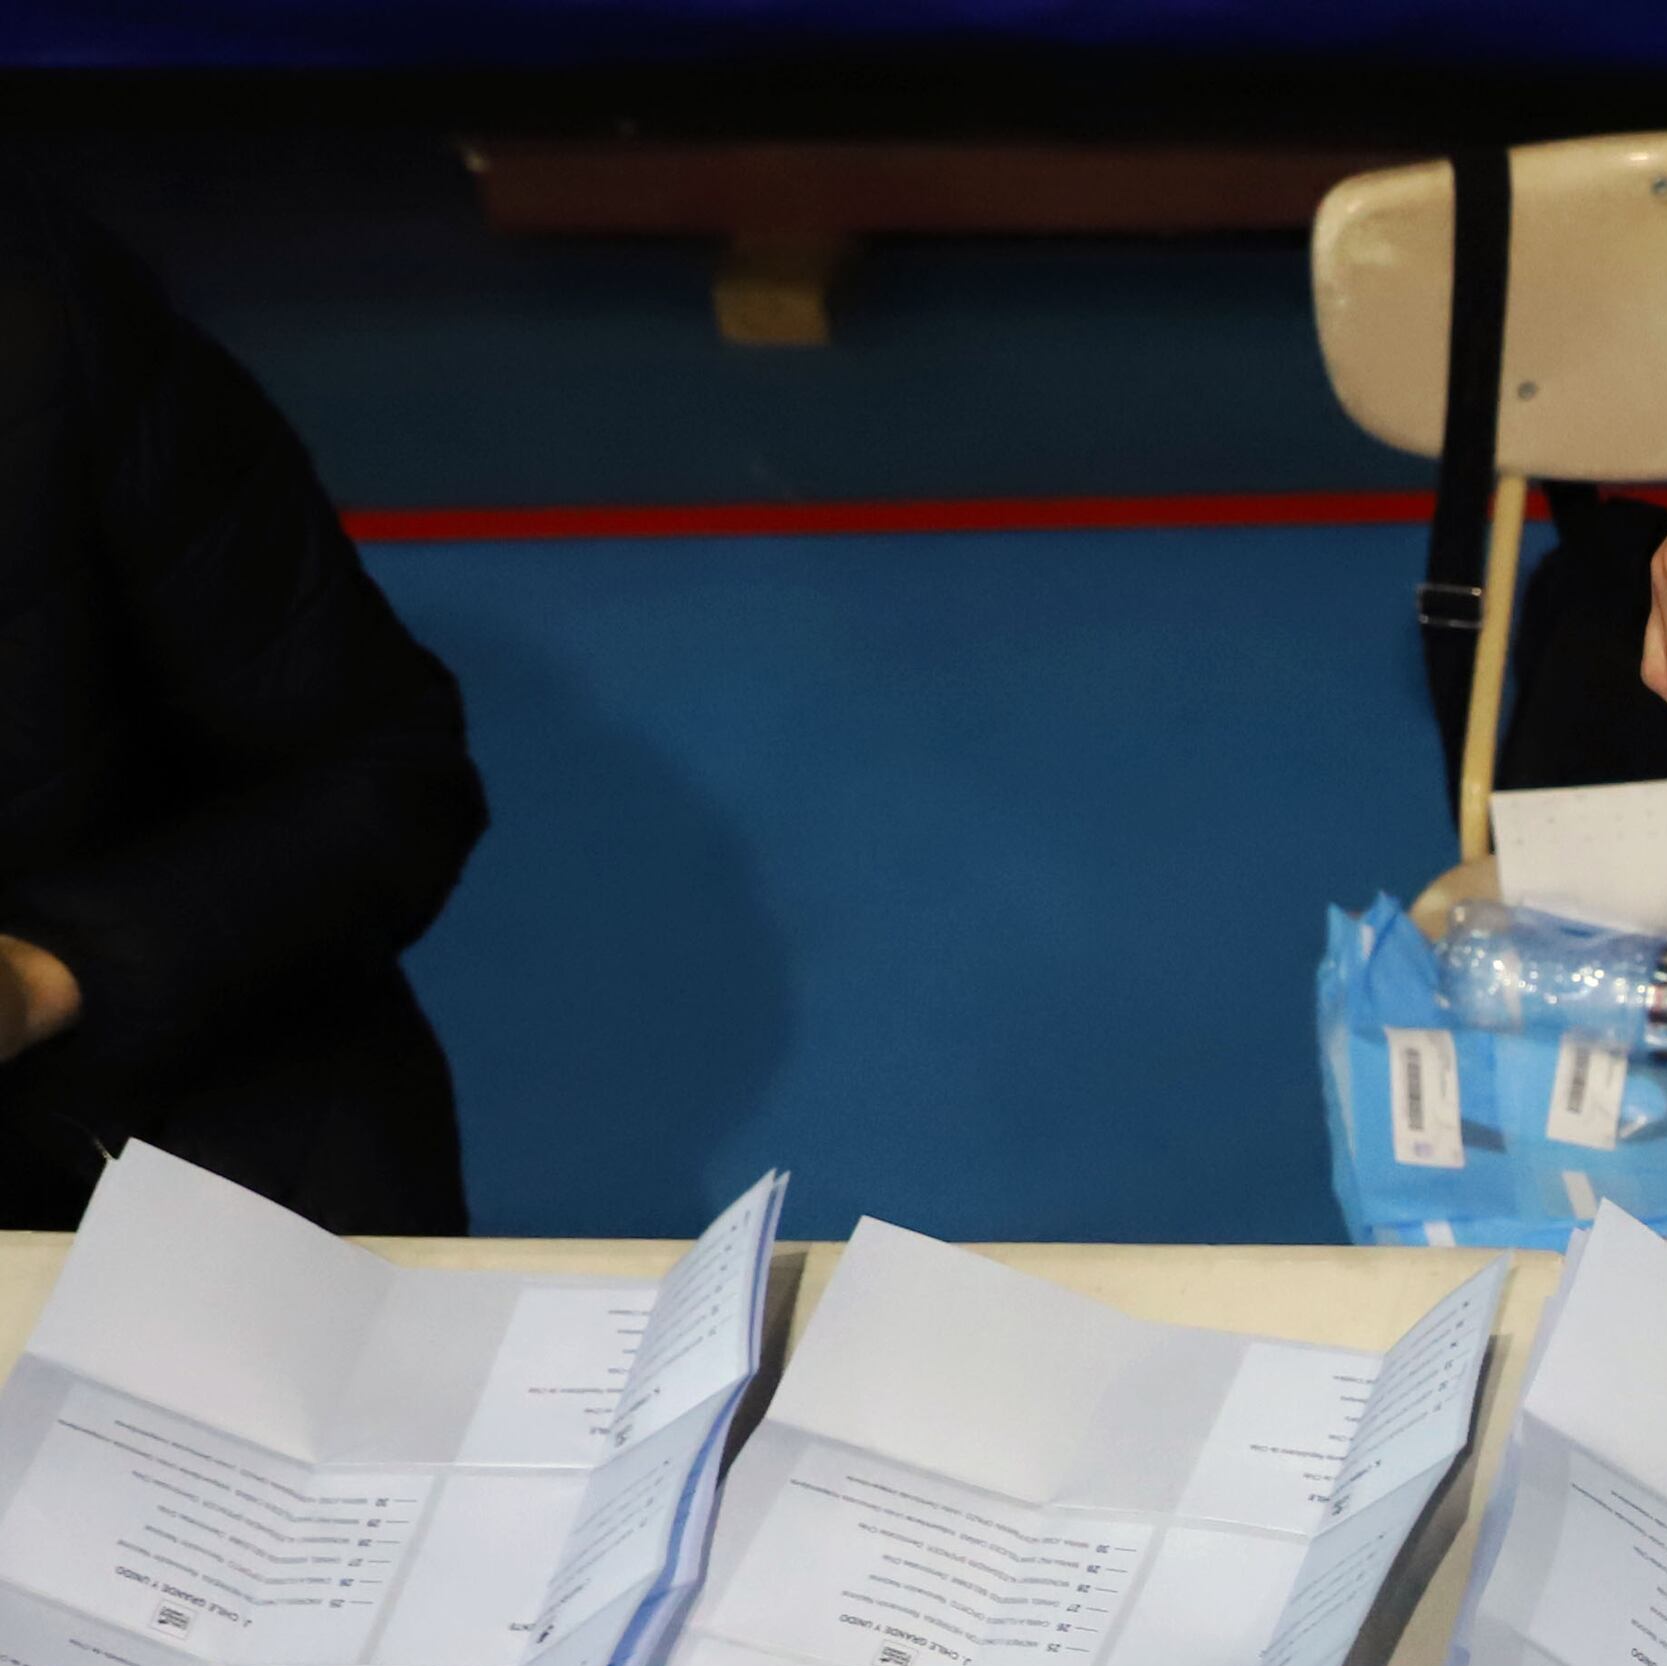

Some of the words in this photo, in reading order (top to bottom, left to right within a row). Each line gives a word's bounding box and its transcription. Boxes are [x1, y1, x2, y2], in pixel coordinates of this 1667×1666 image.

[115, 1565, 150, 1588] UNIDO
[162, 1583, 206, 1608] GRANDE
[208, 1601, 239, 1622] CHILE
[839, 1614, 873, 1629] UNIDO
[885, 1625, 927, 1647] GRANDE
[929, 1642, 959, 1660] CHILE
